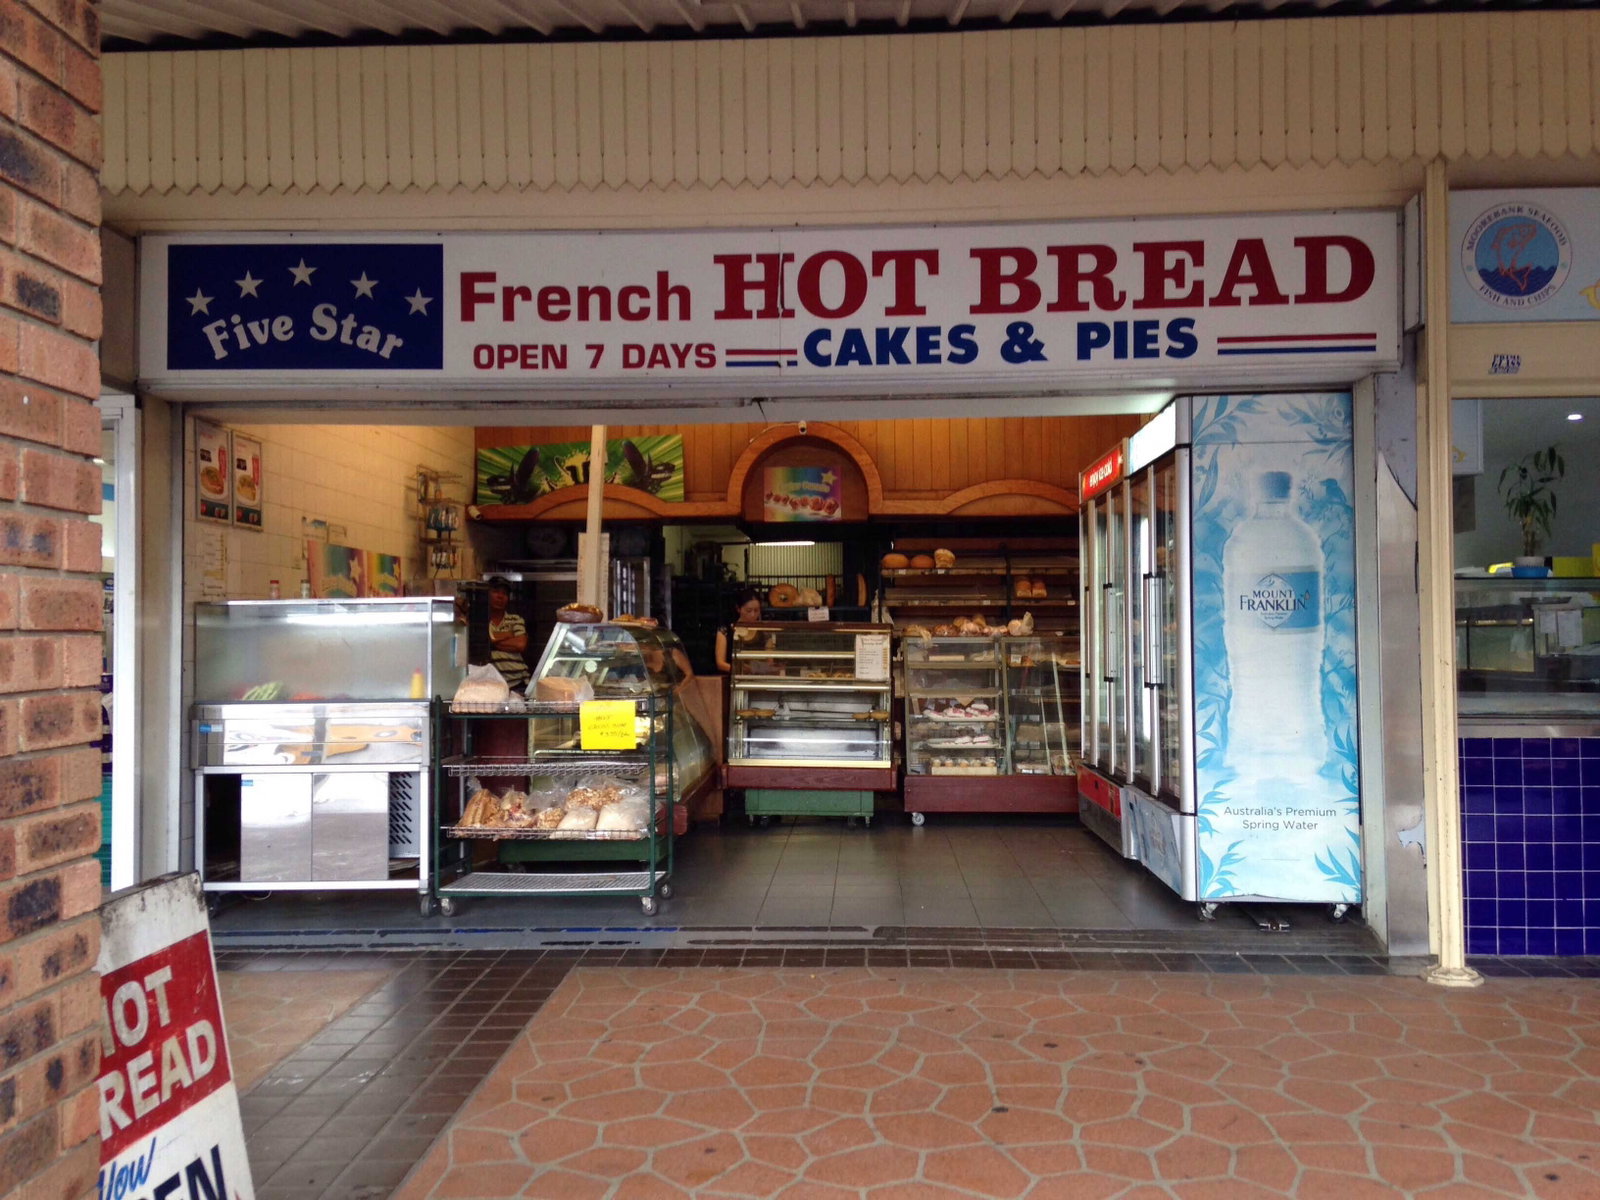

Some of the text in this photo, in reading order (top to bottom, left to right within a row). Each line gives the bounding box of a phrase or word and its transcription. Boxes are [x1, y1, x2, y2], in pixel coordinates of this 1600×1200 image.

[459, 236, 1377, 323] French HOT BREAD
[1502, 296, 1526, 307] AND
[202, 303, 404, 360] Five Star
[803, 318, 1199, 368] CAKES & PIES
[473, 344, 718, 370] OPEN 7 DAYS
[1239, 594, 1308, 612] FRANKLIN
[1252, 589, 1293, 599] MOUNT
[1223, 806, 1337, 818] Australia's Premium
[1242, 819, 1319, 832] Spring Water
[96, 1018, 217, 1141] READ
